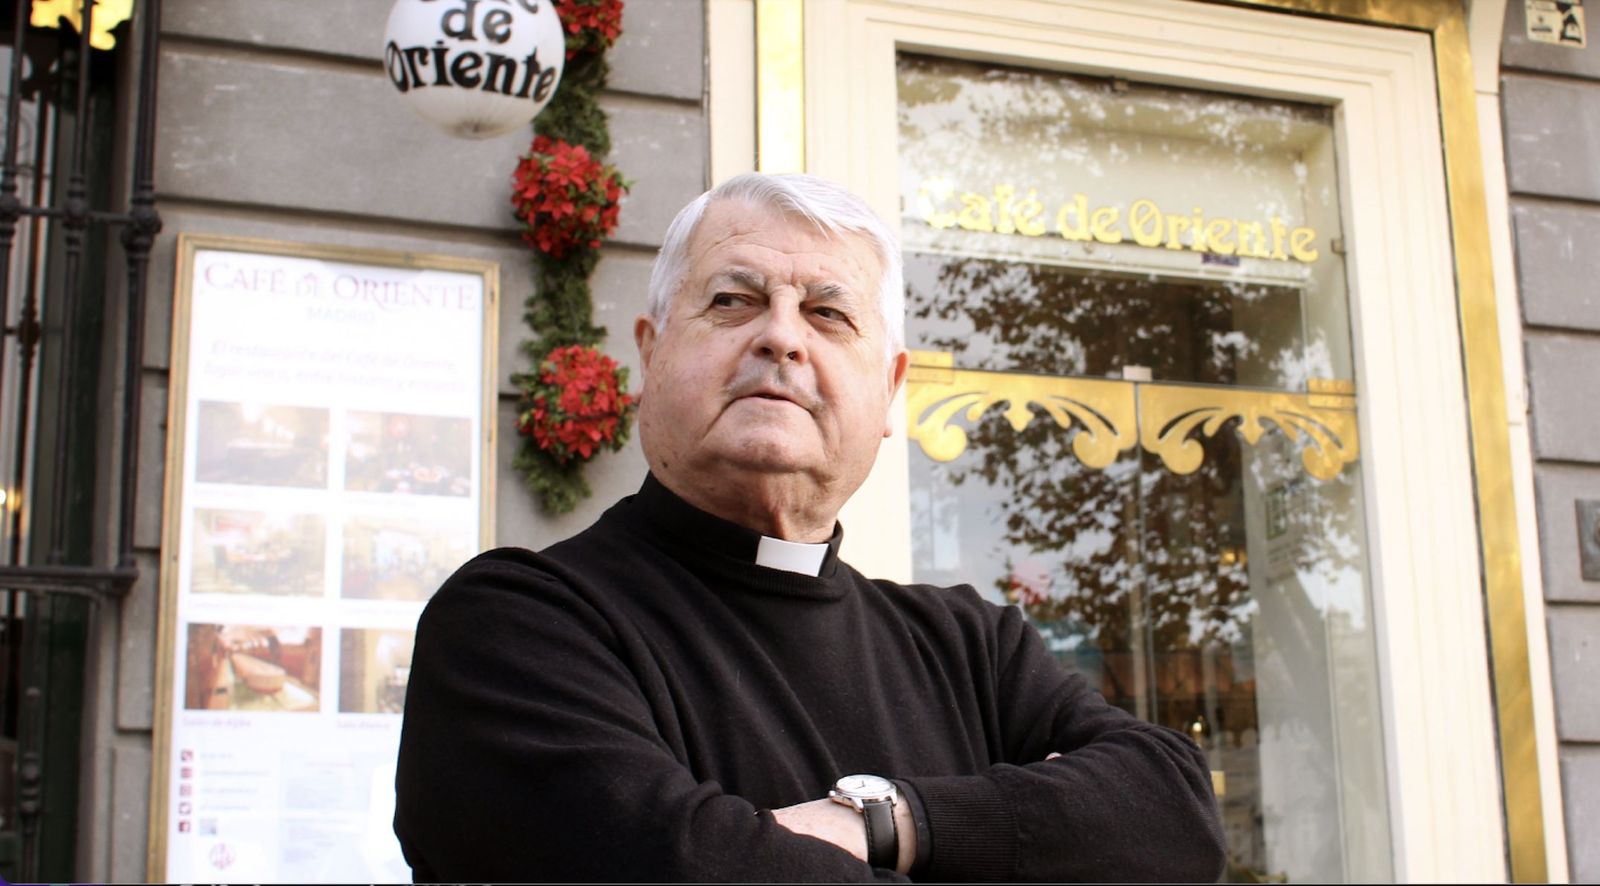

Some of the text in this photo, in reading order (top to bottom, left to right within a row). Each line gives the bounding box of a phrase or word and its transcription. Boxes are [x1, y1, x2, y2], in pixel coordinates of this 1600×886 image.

[441, 0, 512, 44] de
[386, 40, 556, 103] Oriente
[1057, 193, 1122, 243] de
[1128, 198, 1319, 263] Oriente
[333, 273, 477, 310] ORIENTE
